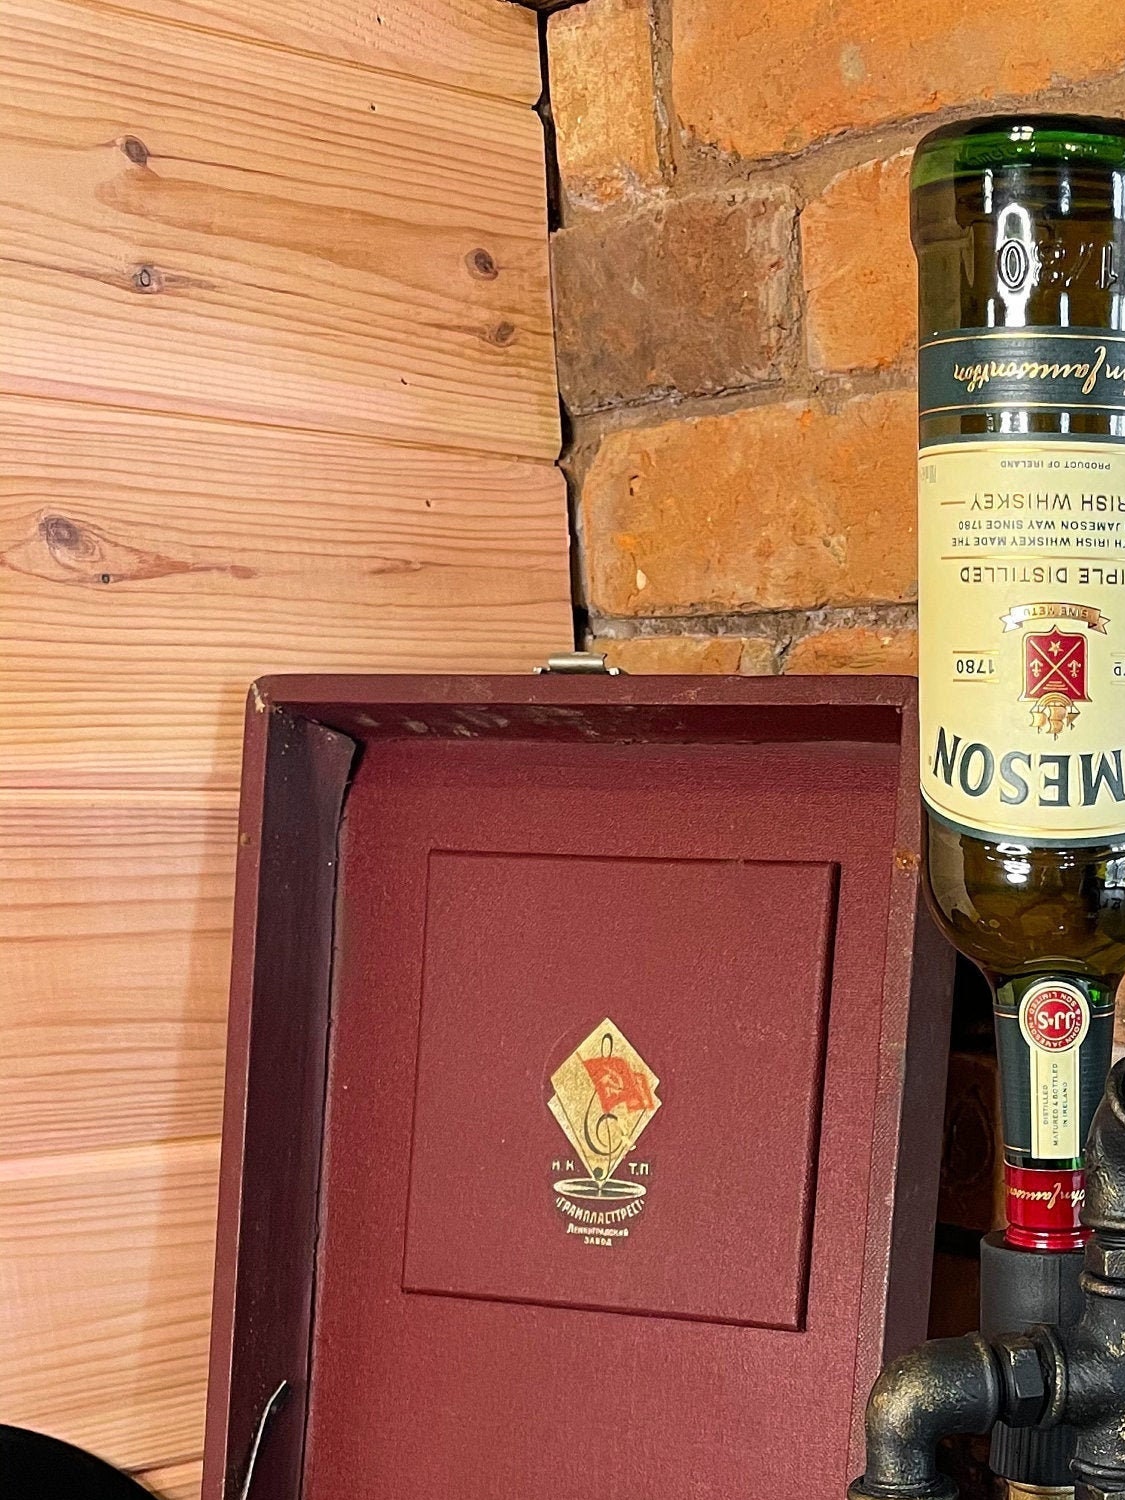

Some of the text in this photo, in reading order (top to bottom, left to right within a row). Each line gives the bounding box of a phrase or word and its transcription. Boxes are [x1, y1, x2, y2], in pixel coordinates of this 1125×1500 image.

[1000, 460, 1111, 470] PRODUCT OF IRELAND
[970, 493, 1072, 511] WHISKEY
[958, 520, 983, 530] 1780
[986, 520, 1023, 530] SINCE
[1027, 520, 1055, 530] WAY
[1061, 520, 1120, 532] JAMESON
[952, 537, 971, 547] THE
[974, 537, 1007, 547] MADE
[1011, 537, 1071, 547] WHISKEY
[1076, 538, 1111, 548] IRISH
[960, 567, 1068, 584] DISTILLED
[1061, 606, 1089, 619] SINE
[956, 659, 995, 675] 1780
[1028, 992, 1057, 1014] LIMITED
[1060, 993, 1077, 1006] SON
[1028, 1022, 1081, 1048] JOHN JAMESON
